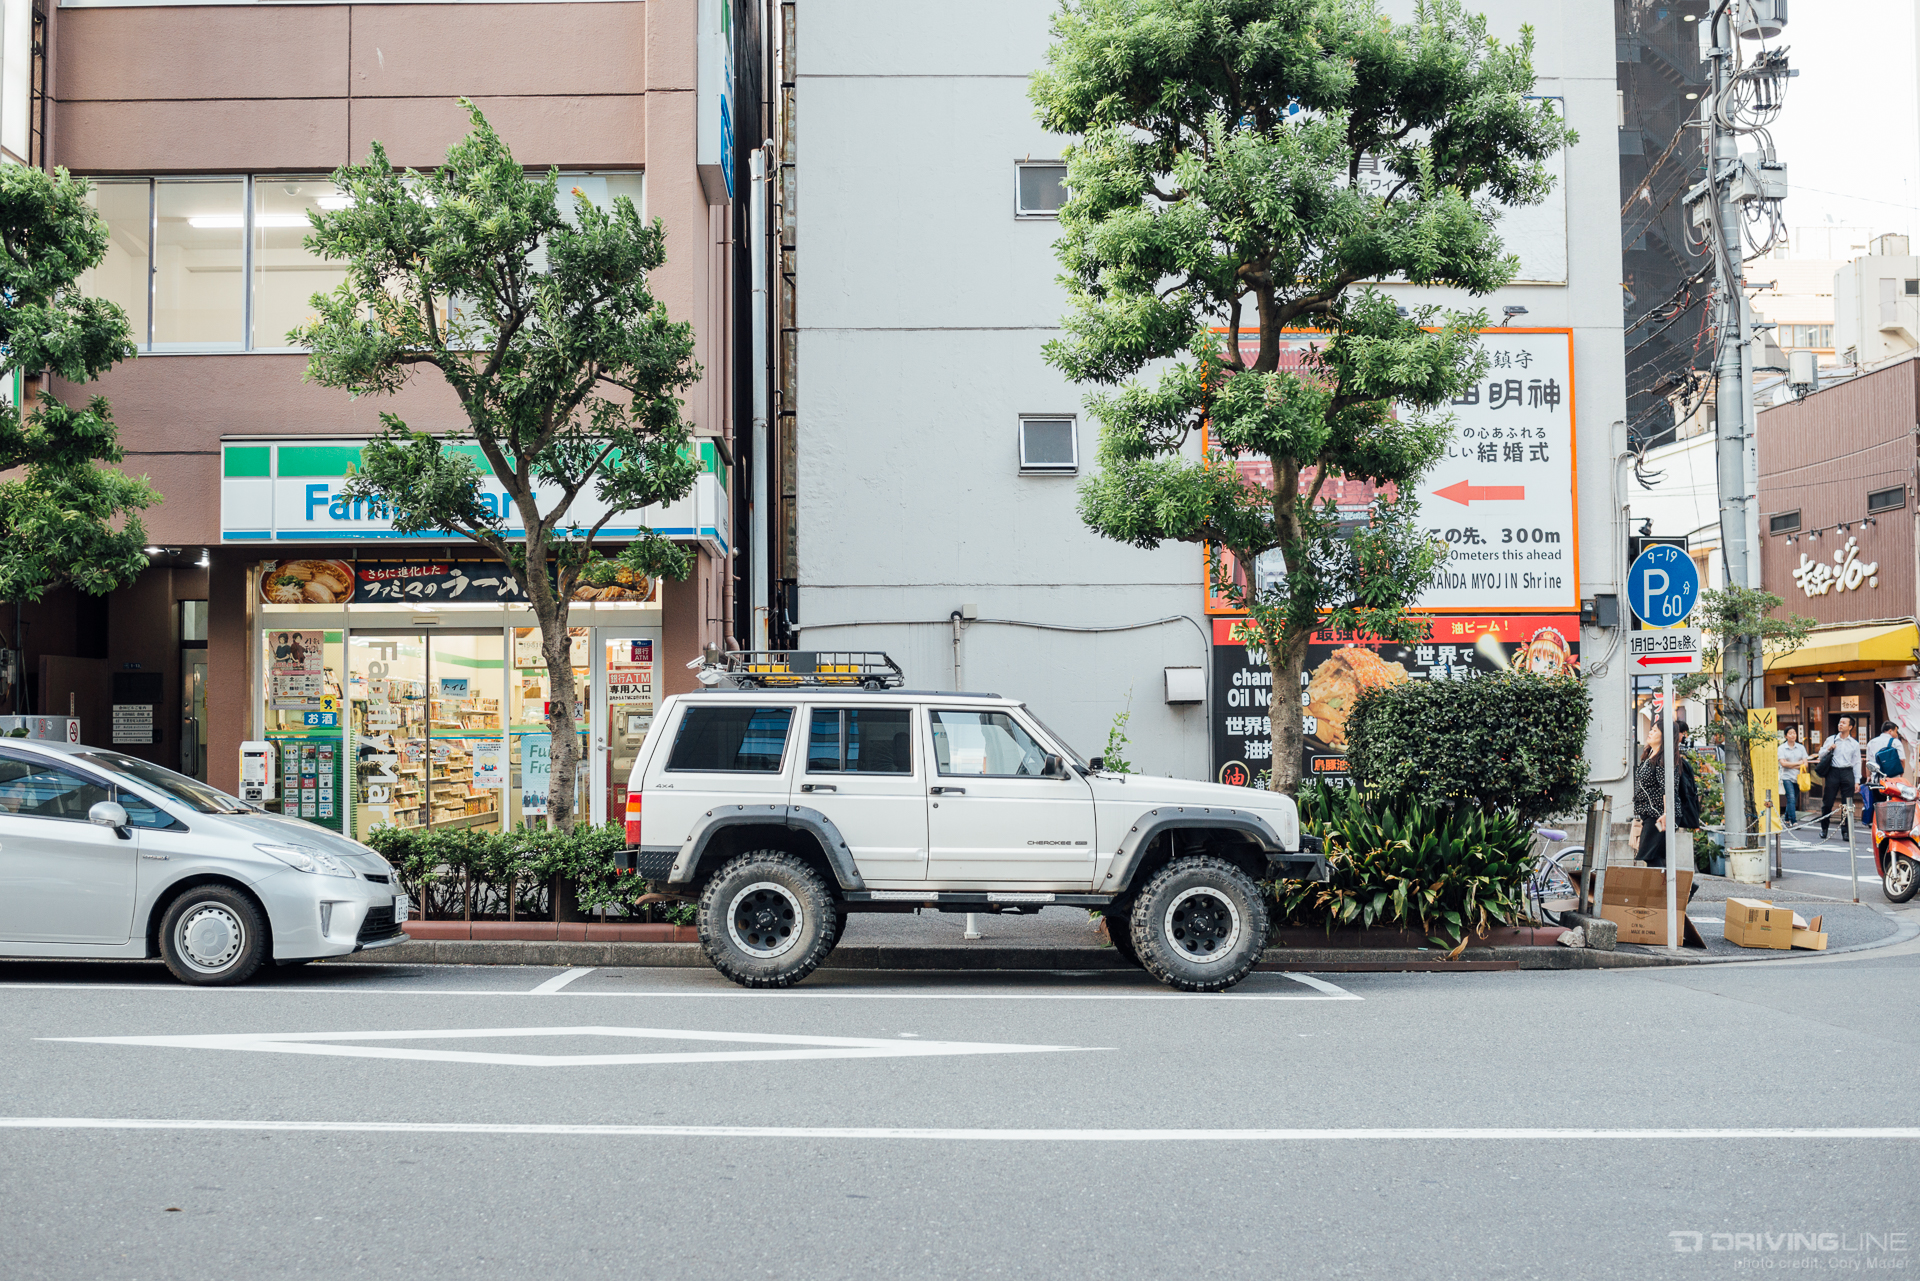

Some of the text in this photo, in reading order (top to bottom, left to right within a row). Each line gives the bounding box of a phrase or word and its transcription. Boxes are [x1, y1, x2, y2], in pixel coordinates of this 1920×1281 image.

[1463, 427, 1547, 440] の心あふれる
[1449, 441, 1550, 463] しい結婚式
[305, 483, 537, 521] Famar
[1501, 528, 1561, 544] 300m
[1502, 549, 1524, 560] this
[1526, 549, 1562, 560] ahead
[1647, 548, 1678, 564] 9-19
[367, 564, 441, 580] さらに進化した
[363, 568, 529, 600] ファミマのラーメ
[1471, 572, 1518, 590] MYOJIN
[1523, 572, 1562, 589] Shrine
[1682, 581, 1691, 595] 分
[1643, 568, 1682, 619] P 60
[634, 647, 650, 655] 銀行
[1415, 645, 1474, 666] 世界で
[1232, 667, 1309, 687] chamn
[443, 683, 466, 691] トイレ
[609, 684, 652, 694] 専用入口
[1227, 688, 1311, 708] Oil Noe
[307, 713, 334, 725] お酒
[1225, 715, 1318, 736] 世界的
[529, 744, 553, 758] Fu
[529, 760, 552, 774] Fre
